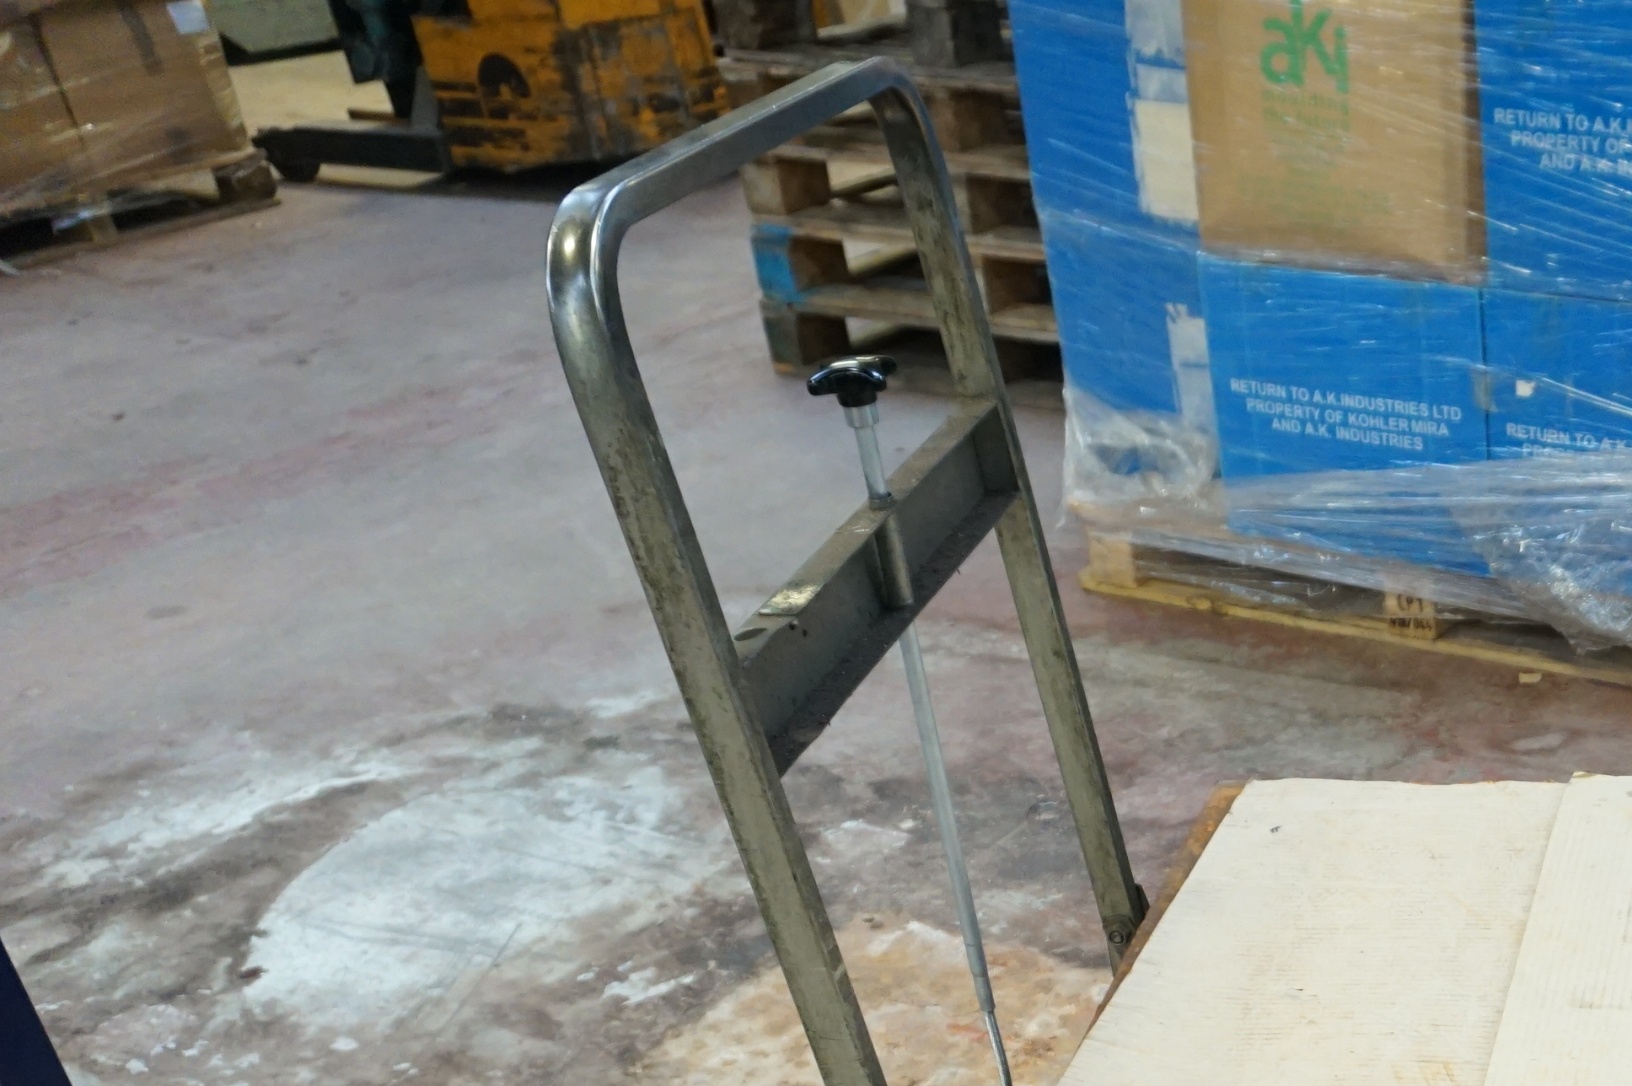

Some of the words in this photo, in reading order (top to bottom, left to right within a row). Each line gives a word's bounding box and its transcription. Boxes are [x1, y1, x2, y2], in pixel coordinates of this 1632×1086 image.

[1493, 107, 1561, 129] RETURN
[1565, 113, 1590, 131] TO
[1510, 129, 1601, 153] PROPERTY
[1605, 137, 1629, 154] OF
[1540, 152, 1577, 170] AND
[1230, 378, 1287, 398] RETURN
[1289, 386, 1311, 402] TO
[1432, 404, 1463, 421] LTD
[1245, 397, 1320, 420] PROPERTY
[1324, 409, 1345, 424] OF
[1348, 411, 1410, 432] KOHLER
[1410, 419, 1449, 437] MIRA
[1272, 417, 1301, 434] AND
[1335, 425, 1424, 451] INDUSTRIES
[1506, 422, 1570, 445] RETURN
[1574, 431, 1597, 449] TO
